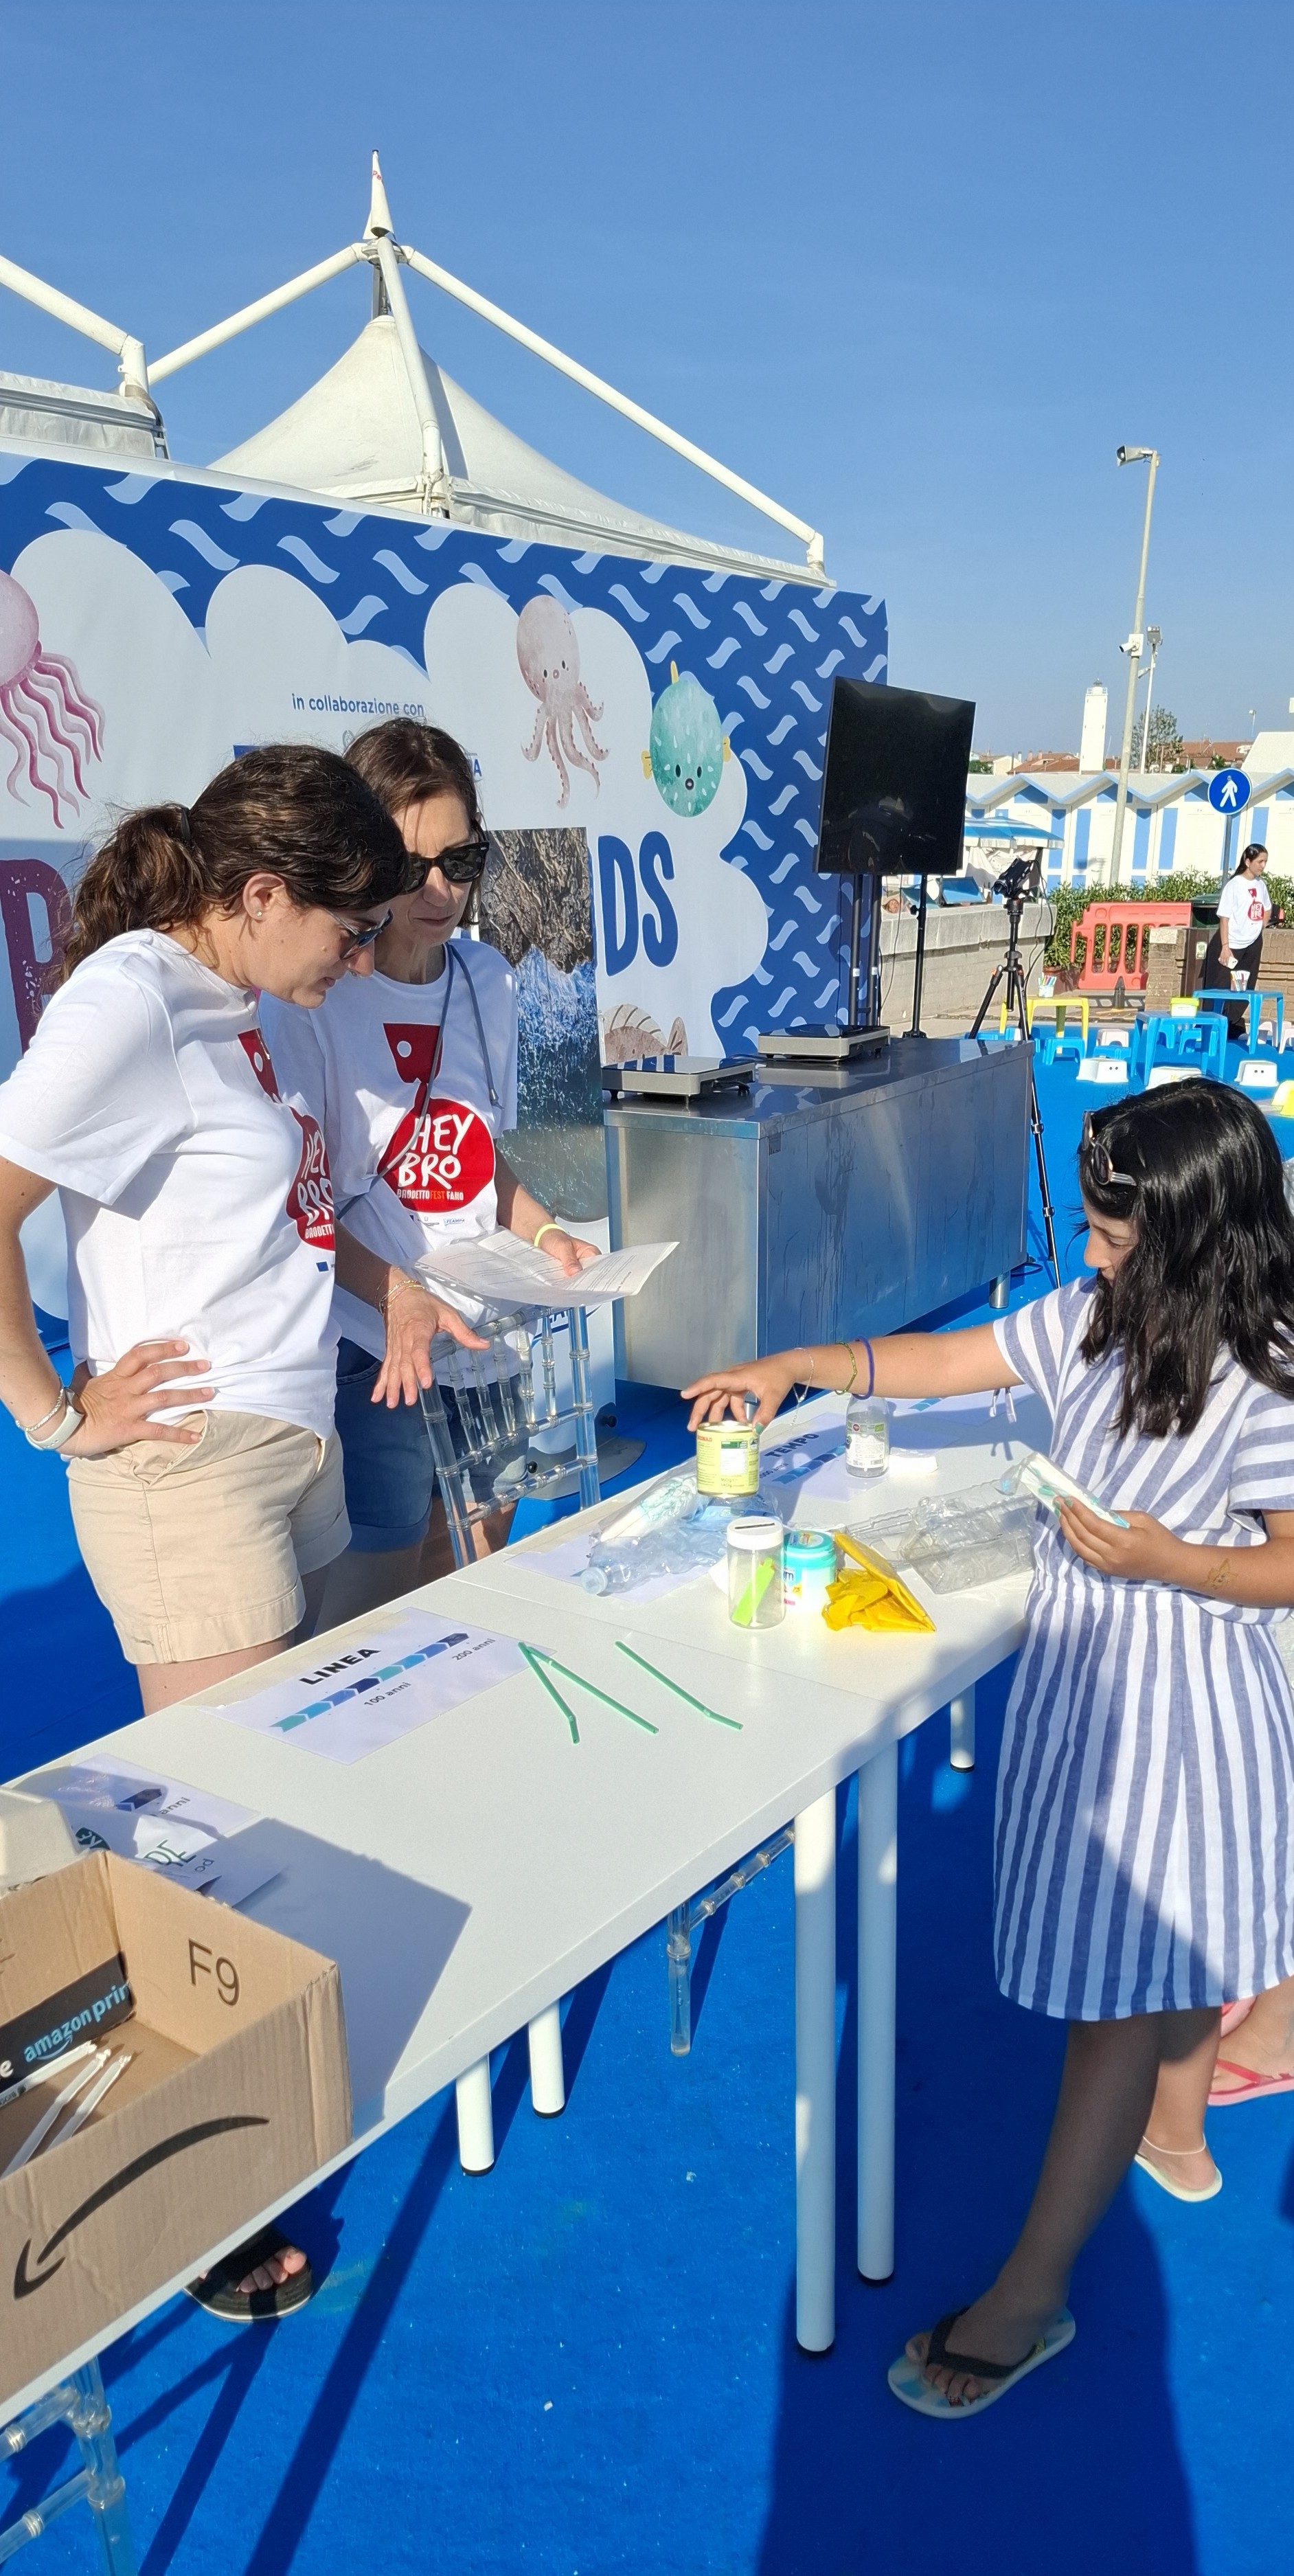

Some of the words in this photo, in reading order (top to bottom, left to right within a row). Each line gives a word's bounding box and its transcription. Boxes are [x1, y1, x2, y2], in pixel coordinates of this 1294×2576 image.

[291, 693, 305, 710] in
[309, 694, 400, 716] collaborazione
[403, 703, 424, 716] con
[589, 831, 679, 977] DS
[411, 1114, 475, 1155] HEY
[301, 1129, 326, 1180] HEY
[398, 1152, 462, 1190] BRO
[764, 1433, 819, 1458] TEMPO
[298, 1647, 382, 1686] LINEA
[451, 1649, 474, 1661] 200
[474, 1638, 496, 1651] anni
[363, 1693, 385, 1707] 100
[386, 1682, 411, 1697] anni
[159, 1796, 191, 1815] anni
[188, 1936, 240, 2007] F9
[23, 2008, 92, 2063] amazon
